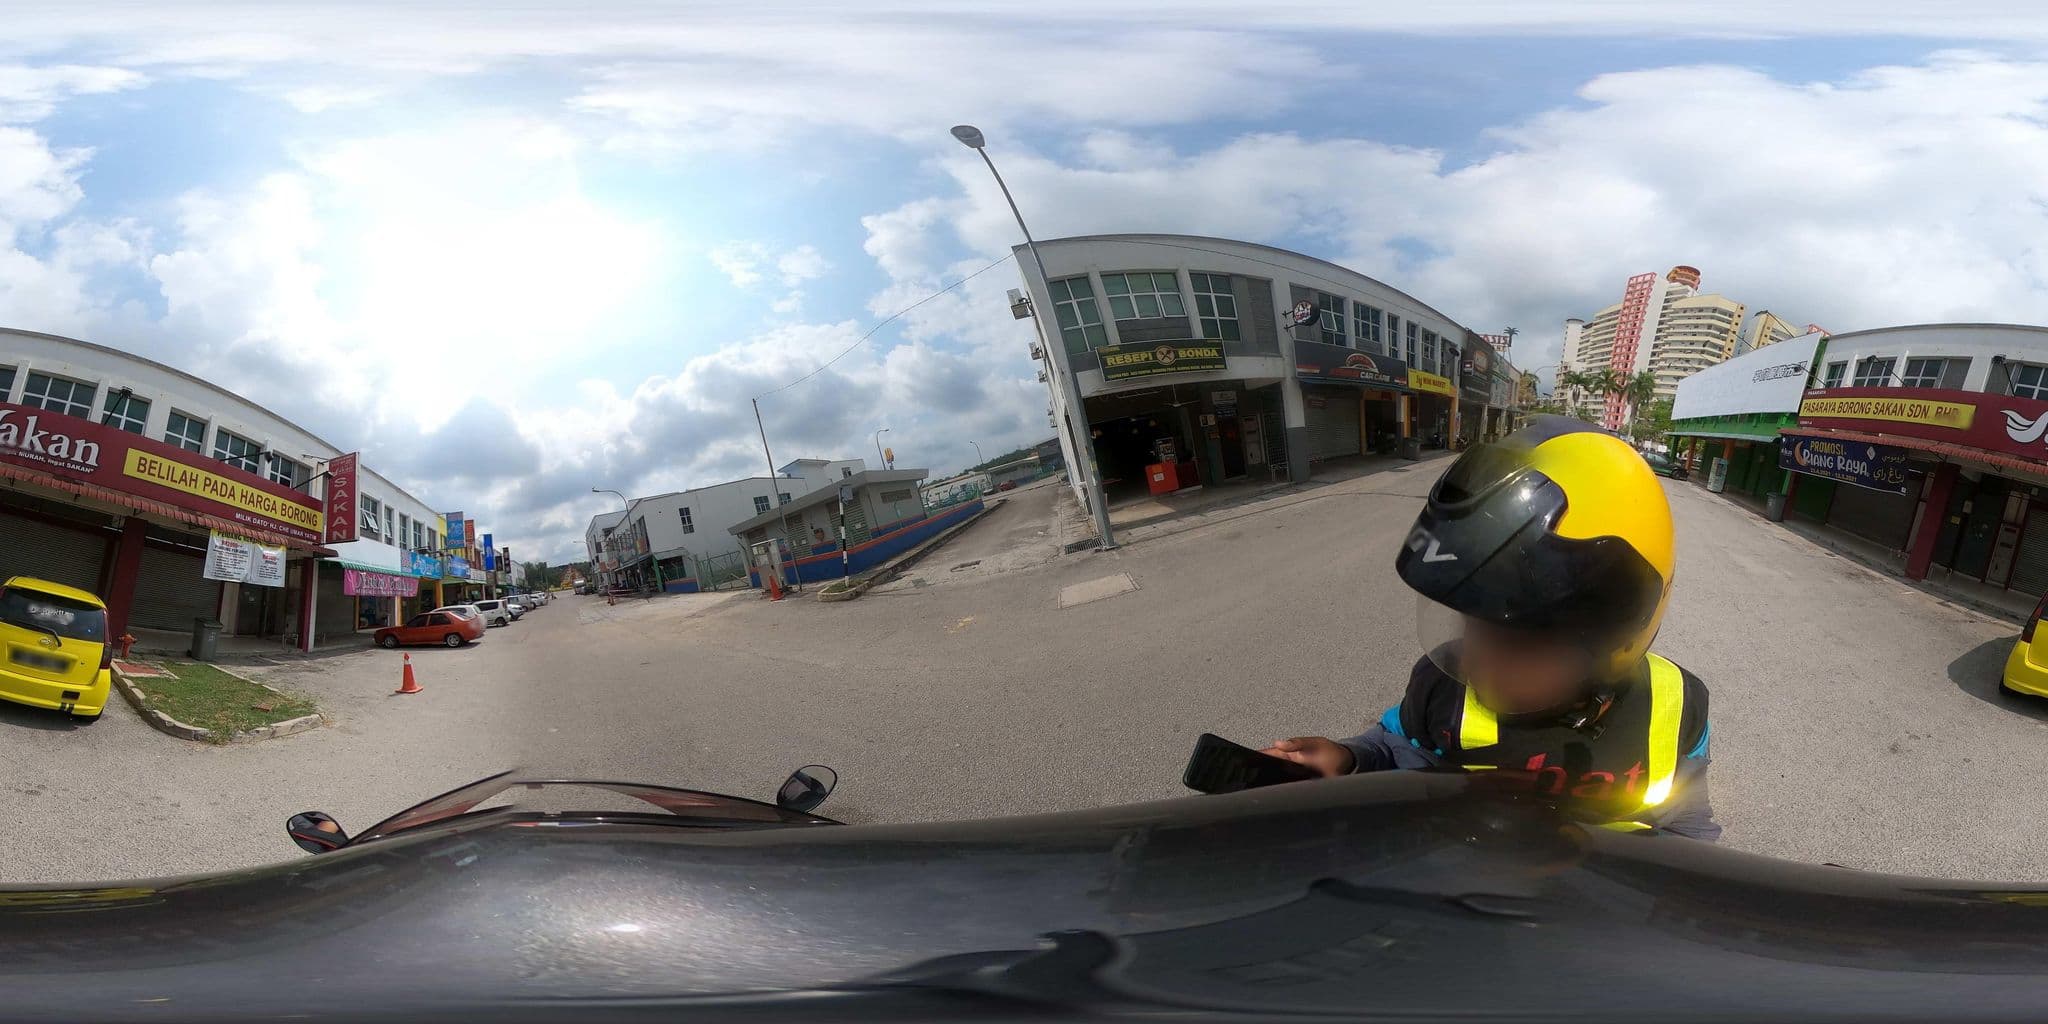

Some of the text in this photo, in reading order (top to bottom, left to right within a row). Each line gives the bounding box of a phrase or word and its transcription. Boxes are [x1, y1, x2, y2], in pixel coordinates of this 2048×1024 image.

[1106, 348, 1218, 366] RESEPI BONDA
[1360, 371, 1373, 379] CAR
[1802, 402, 1837, 414] PASARAYA
[1837, 402, 1872, 414] BORONG
[1873, 404, 1905, 416] SAKAN
[1907, 405, 1930, 419] SDN
[0, 409, 99, 467] akan
[1802, 449, 1834, 469] RIANG
[136, 455, 318, 527] BELILAH PADA HARGA BORONG
[332, 477, 349, 541] SAKAN
